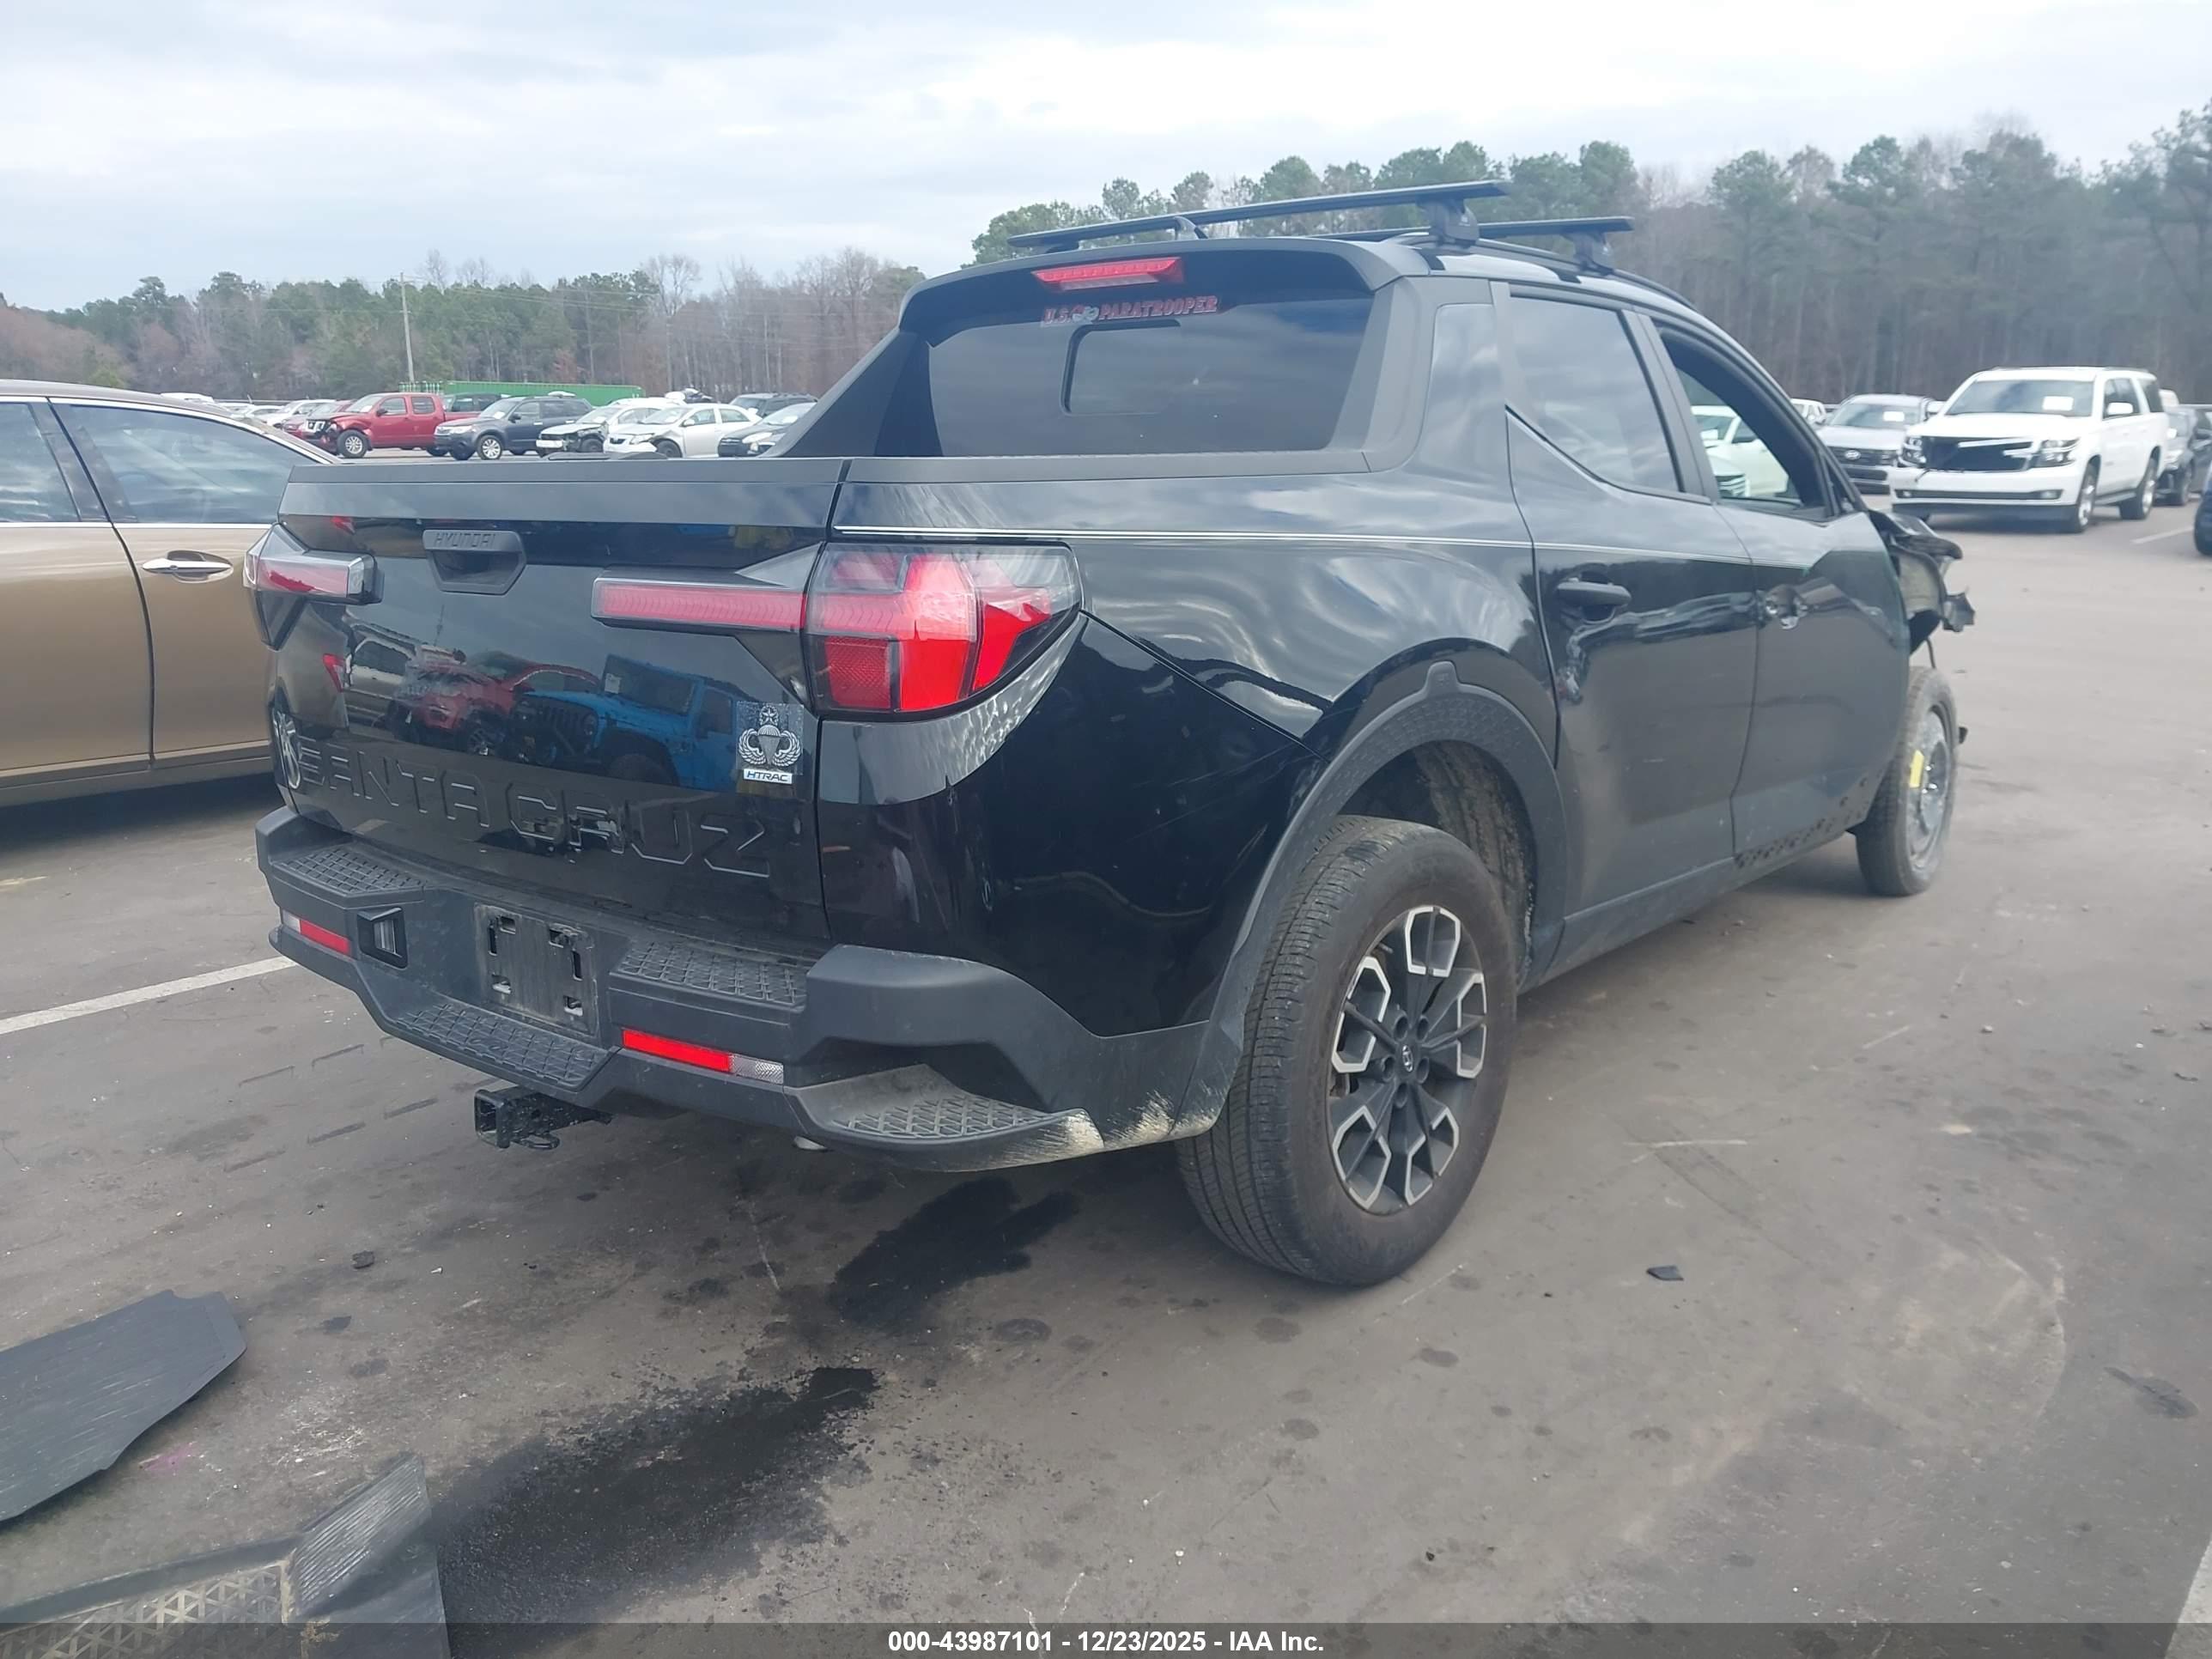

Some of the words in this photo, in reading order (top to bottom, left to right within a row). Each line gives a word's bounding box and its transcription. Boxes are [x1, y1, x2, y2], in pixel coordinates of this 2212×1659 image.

[1098, 295, 1218, 320] PARATROOPER
[434, 532, 496, 549] HYUNDAI
[747, 770, 789, 782] HTRAC
[296, 734, 490, 830] SANTA
[505, 782, 770, 878] CRUZ
